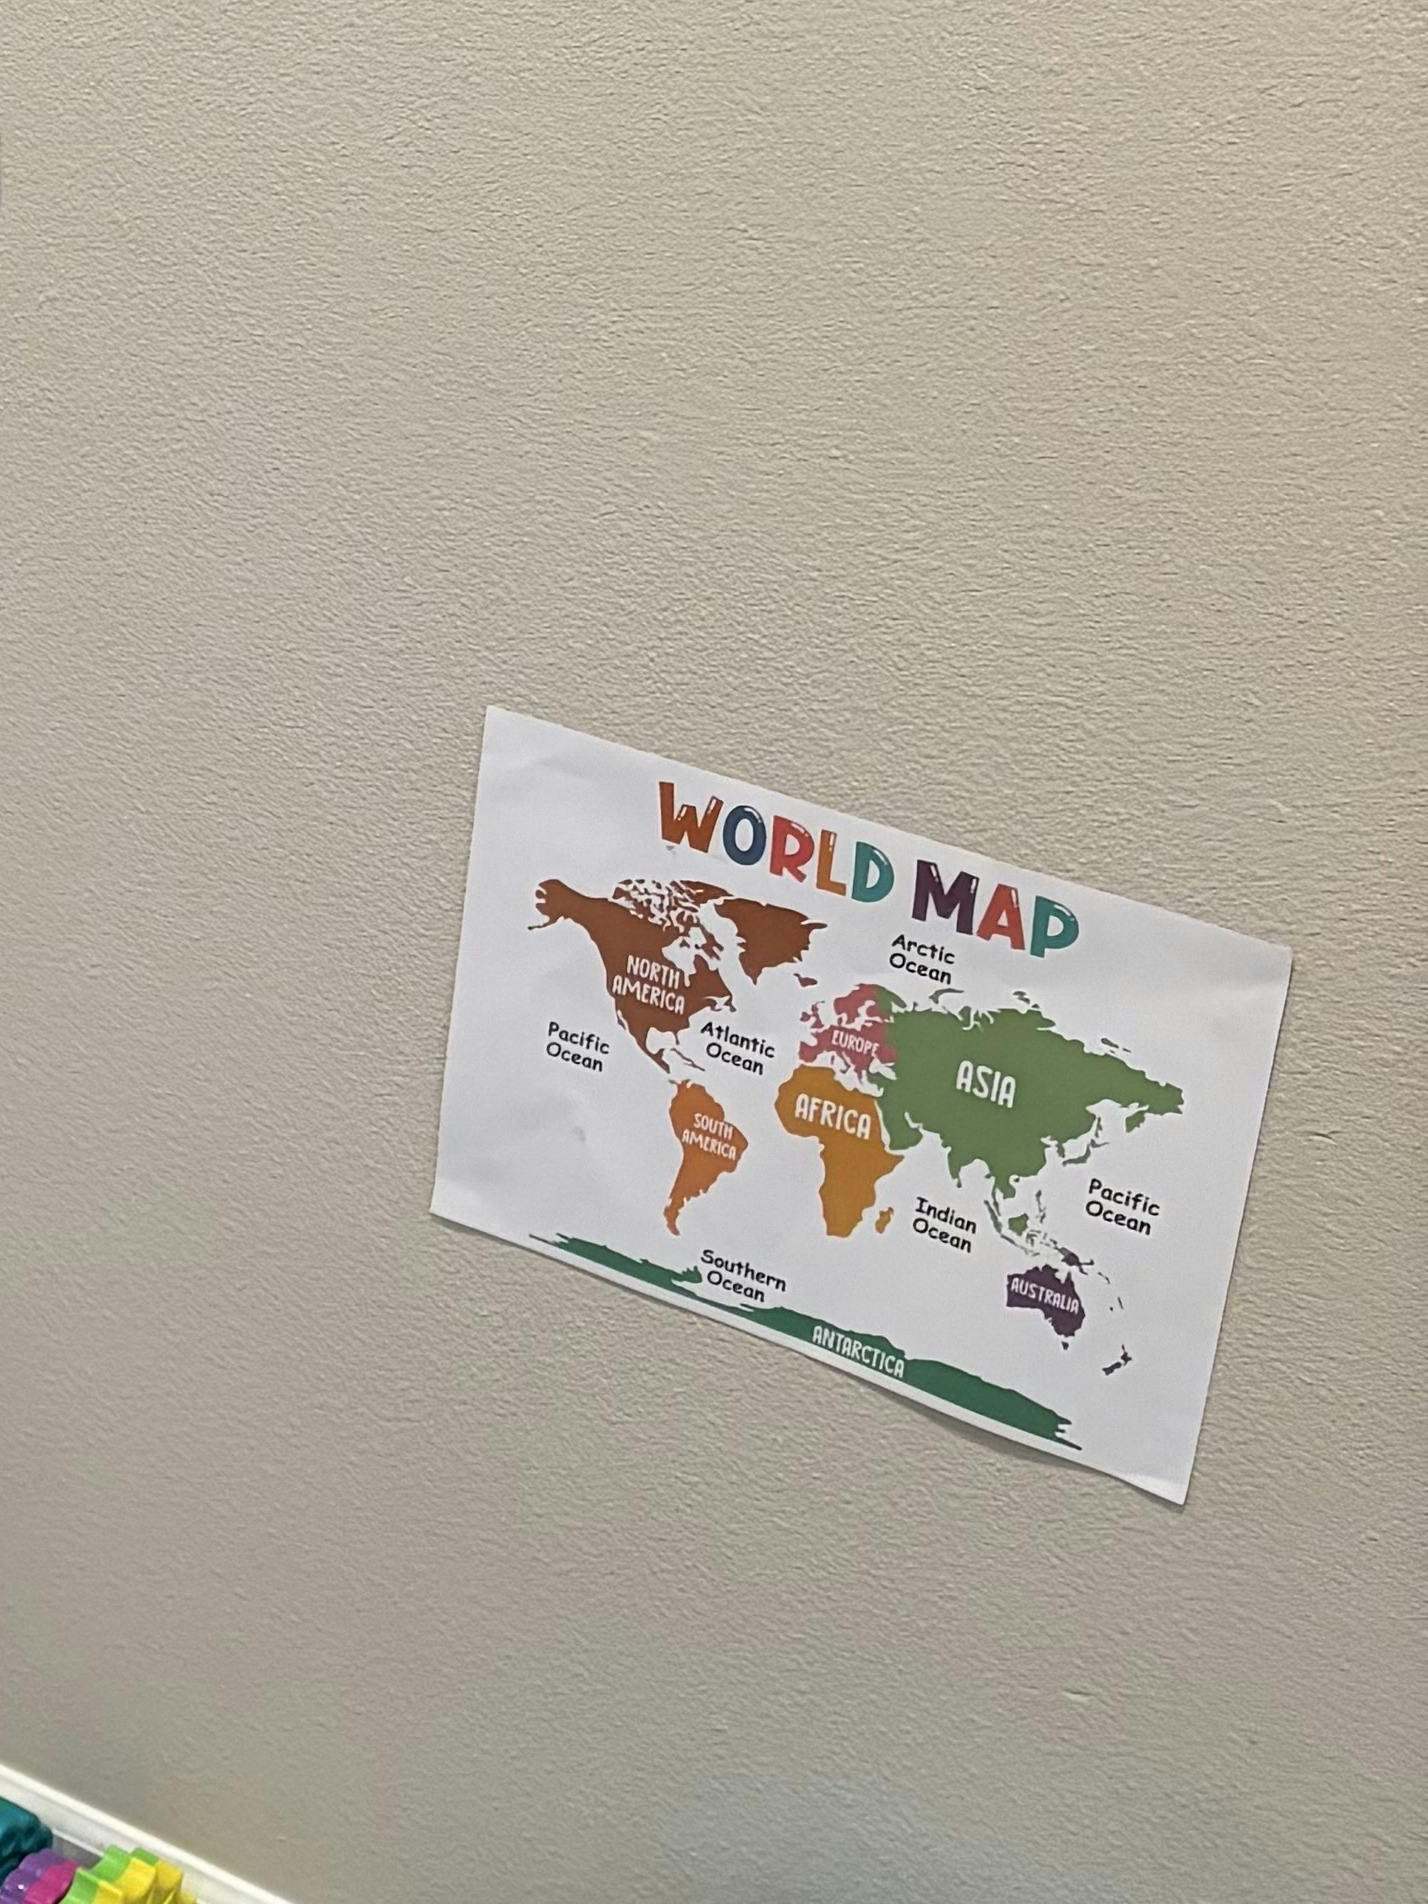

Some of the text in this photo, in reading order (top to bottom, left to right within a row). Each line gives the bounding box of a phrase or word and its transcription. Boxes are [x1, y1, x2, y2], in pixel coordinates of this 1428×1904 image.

[658, 781, 1080, 959] WORLD MAP
[889, 933, 956, 967] Arctic
[626, 954, 681, 990] NORTH
[888, 952, 953, 986] Ocean
[610, 974, 687, 1016] AMERICA
[546, 1021, 611, 1056] Pacific
[700, 1020, 776, 1059] Atlantic
[830, 1030, 881, 1059] EUROPE
[545, 1042, 604, 1074] Ocean
[704, 1041, 765, 1076] Ocean
[954, 1060, 1018, 1110] ASIA
[692, 1112, 734, 1142] SOUTH
[794, 1095, 873, 1141] AFRICA
[680, 1127, 738, 1162] AMERICA
[915, 1196, 978, 1235] Indian
[1088, 1178, 1161, 1218] Pacific
[911, 1217, 973, 1255] Ocean
[1085, 1200, 1152, 1237] Ocean
[700, 1248, 787, 1293] Southern
[706, 1269, 766, 1304] Ocean
[1009, 1276, 1080, 1316] AUSTRALIA
[811, 1324, 906, 1380] ANTARCTICA
